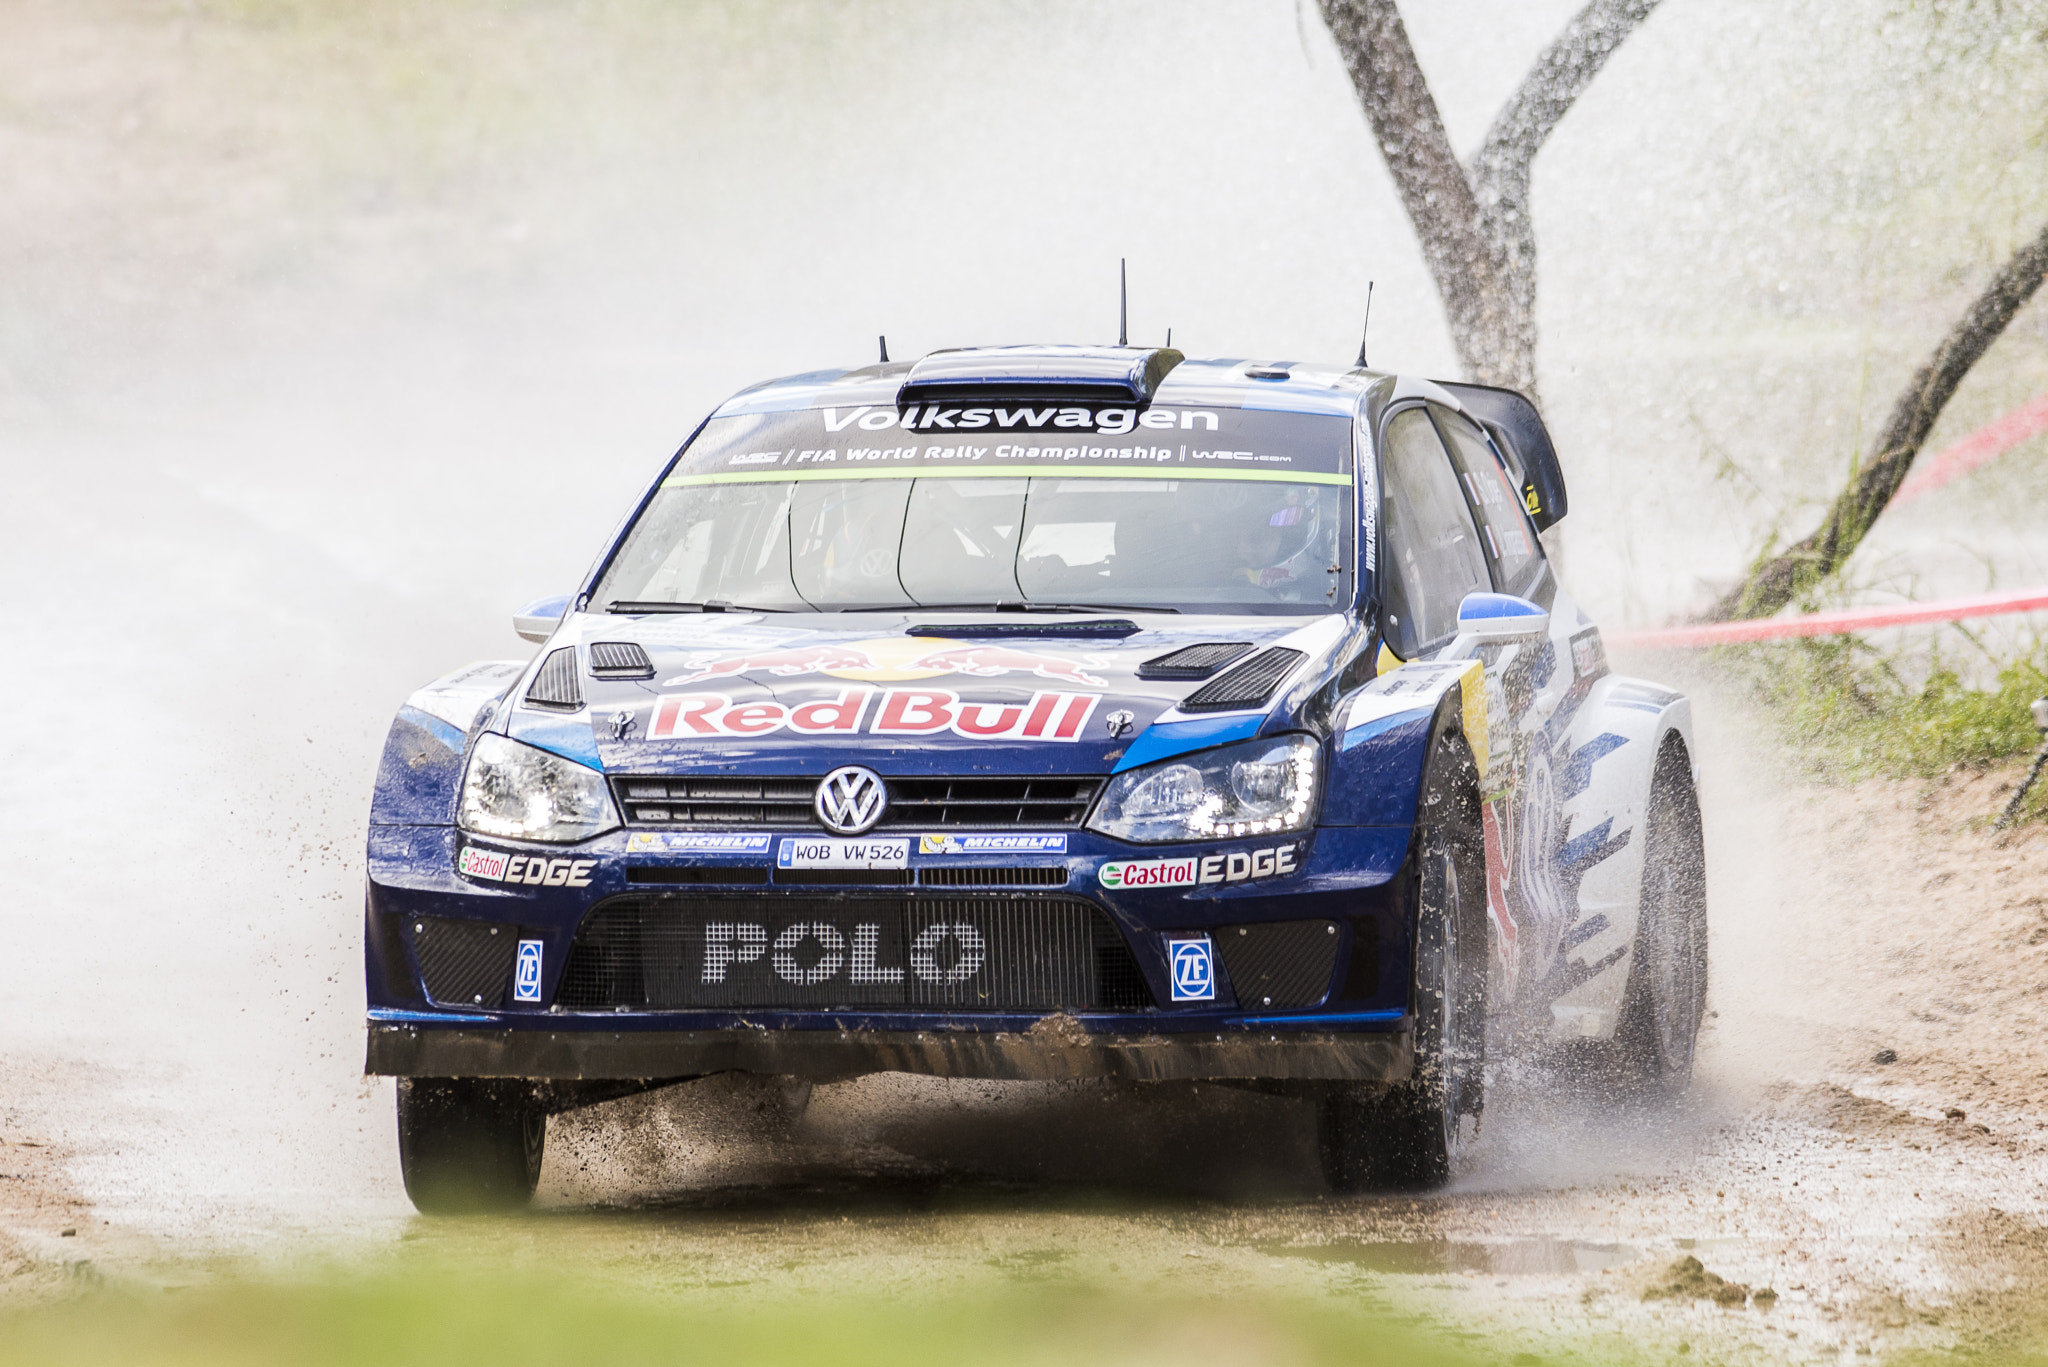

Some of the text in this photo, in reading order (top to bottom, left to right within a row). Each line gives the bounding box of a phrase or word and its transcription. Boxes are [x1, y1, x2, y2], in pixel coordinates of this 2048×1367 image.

[822, 406, 1219, 435] Volkswagen
[796, 450, 837, 463] FIA
[846, 446, 918, 462] World
[923, 445, 988, 461] Rally
[995, 444, 1172, 462] Championship
[650, 687, 1098, 740] Red Bull
[669, 837, 768, 848] MICHELIN
[796, 845, 904, 860] WOB VW 526
[963, 837, 1064, 848] MICHELIN
[466, 851, 599, 888] Castrol EDGE
[1123, 844, 1297, 886] Castrol EDGE
[701, 921, 985, 985] POLO
[1176, 954, 1208, 986] ZF
